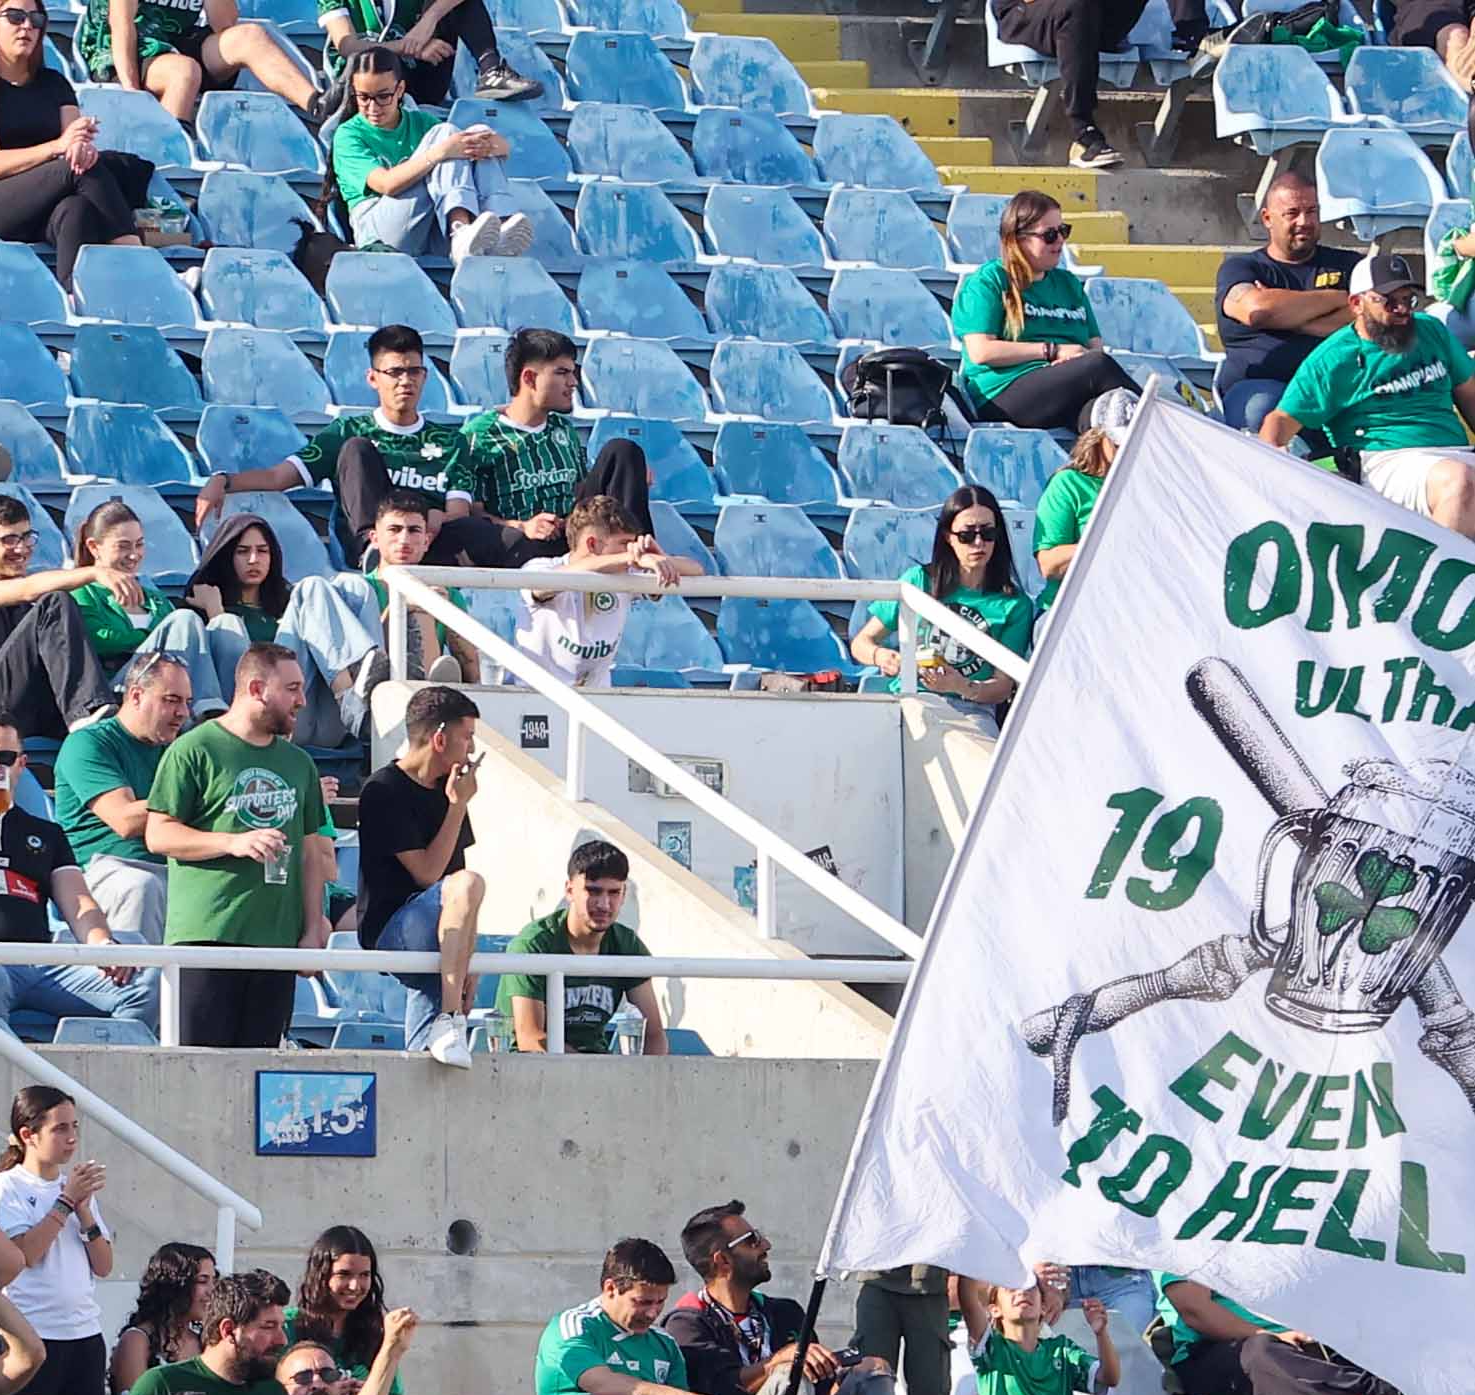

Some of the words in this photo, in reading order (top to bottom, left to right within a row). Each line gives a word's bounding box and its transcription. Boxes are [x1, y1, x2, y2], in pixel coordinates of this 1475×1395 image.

[387, 467, 449, 492] vibet
[1085, 787, 1224, 911] 19
[1169, 1031, 1408, 1152] EVEN
[1175, 1161, 1467, 1274] HELL
